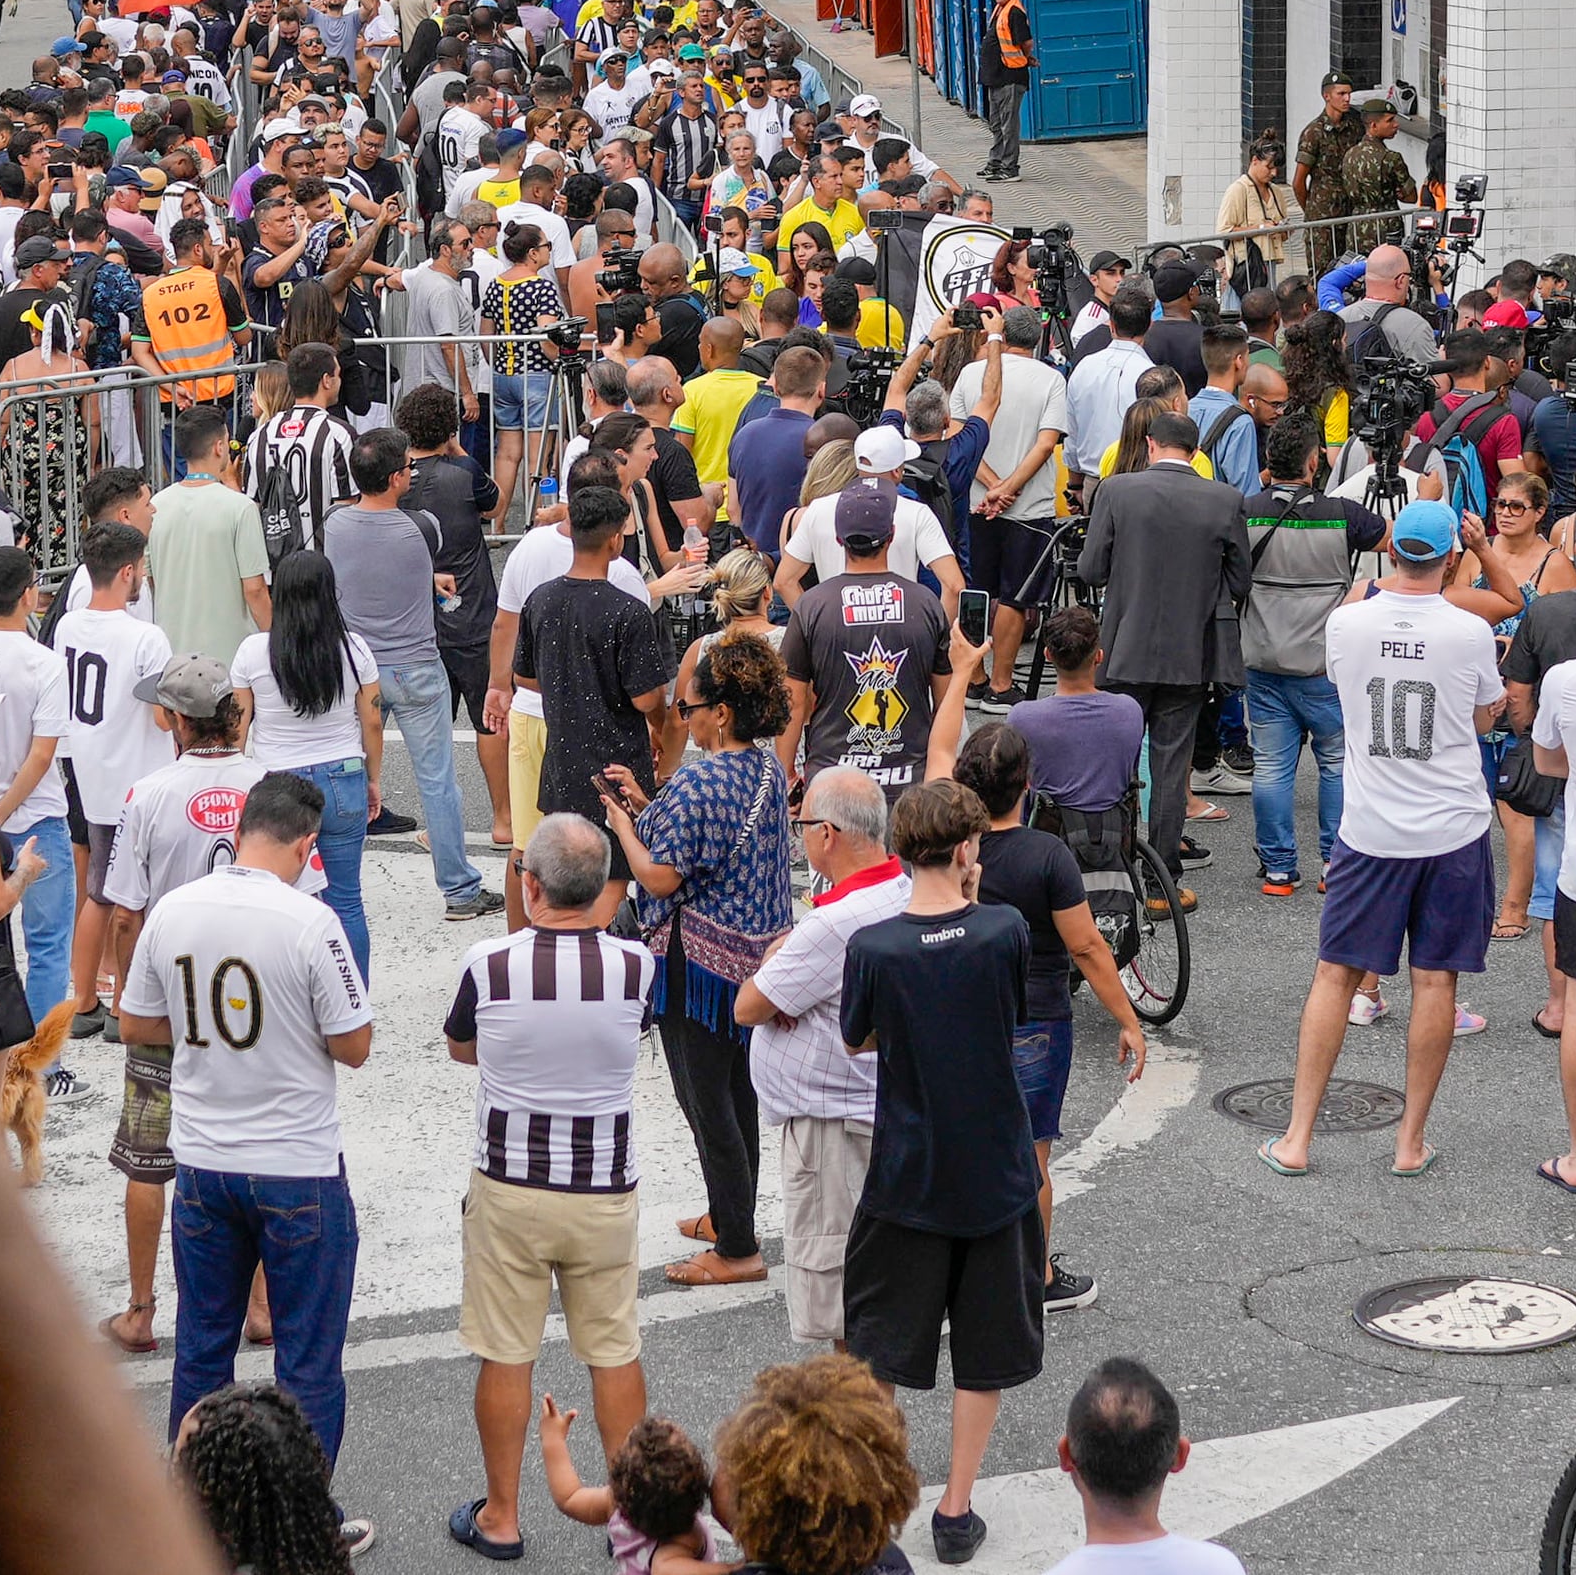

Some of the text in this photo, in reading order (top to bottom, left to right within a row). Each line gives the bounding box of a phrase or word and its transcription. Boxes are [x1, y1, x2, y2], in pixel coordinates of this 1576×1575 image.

[193, 82, 213, 101] 10
[440, 134, 459, 168] 10
[158, 281, 196, 296] STAFF
[158, 302, 212, 327] 102
[1380, 640, 1426, 661] PELÉ
[65, 644, 108, 727] 10
[1365, 676, 1436, 762] 10
[198, 793, 237, 813] BOM
[920, 926, 966, 945] umbro
[326, 937, 363, 1011] NETSHOES
[174, 953, 264, 1051] 10
